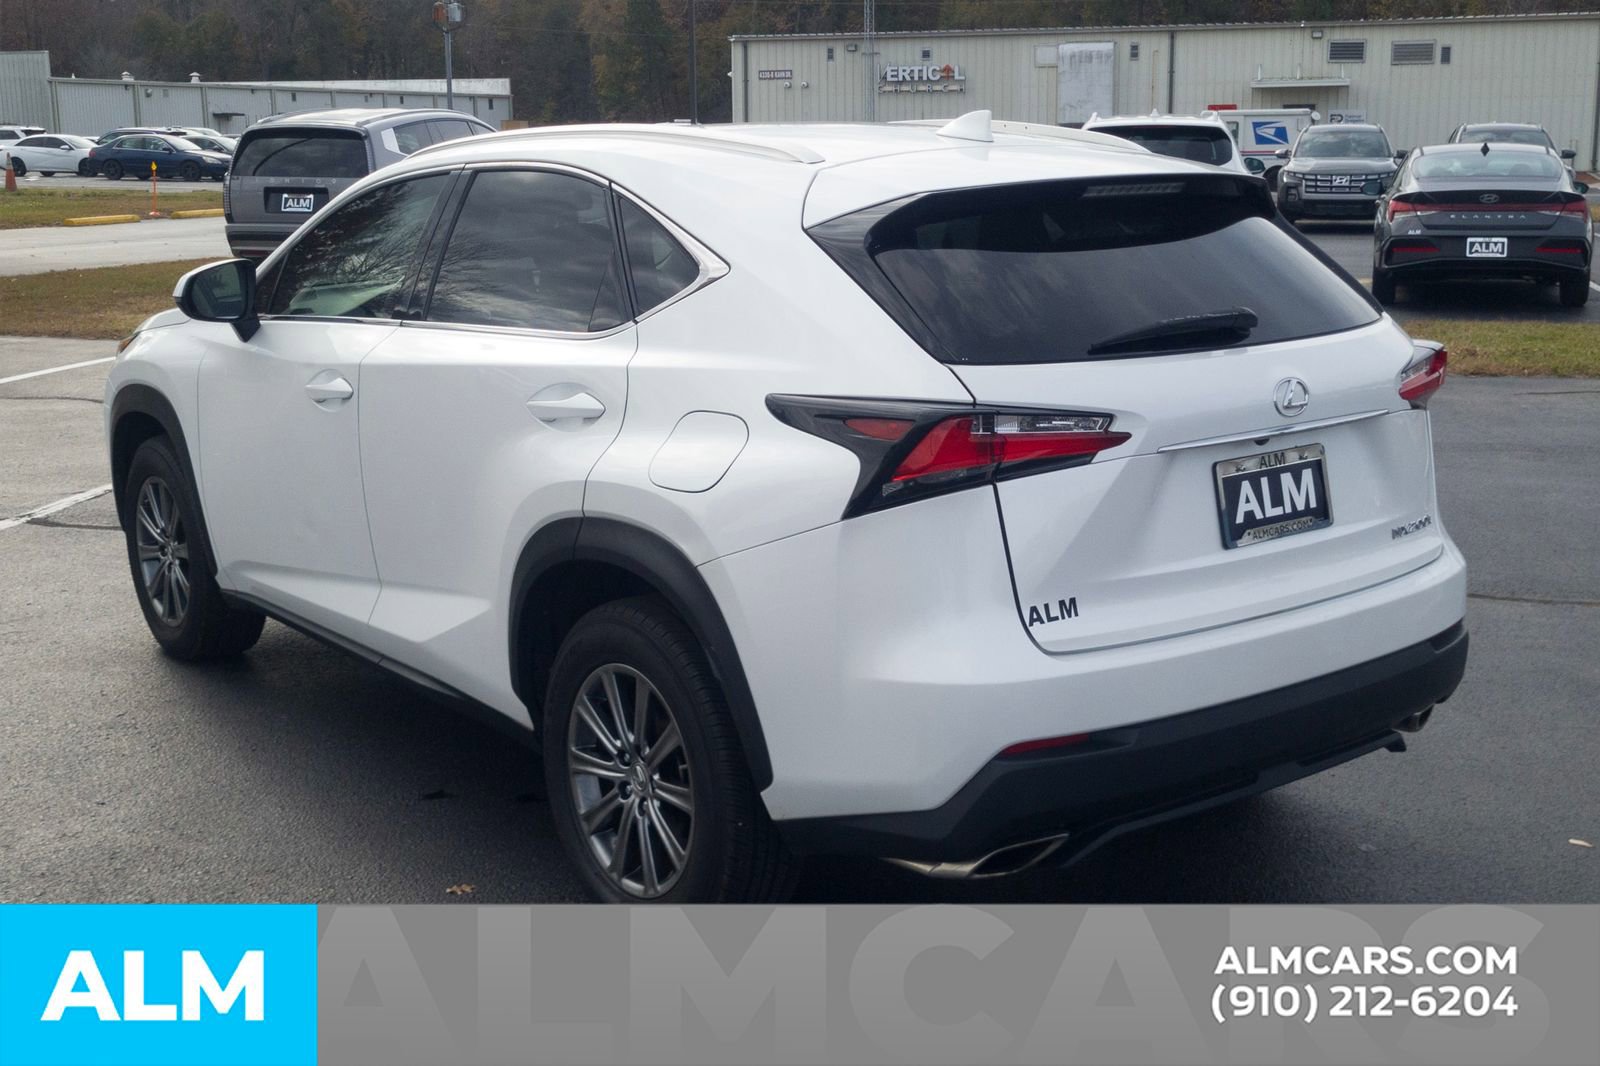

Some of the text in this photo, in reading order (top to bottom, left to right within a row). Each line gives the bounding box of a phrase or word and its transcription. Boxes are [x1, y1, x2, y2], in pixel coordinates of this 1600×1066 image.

[879, 83, 965, 94] CHURCH
[286, 198, 310, 208] ALM
[1471, 242, 1503, 253] ALM
[1259, 452, 1286, 469] ALM
[1235, 468, 1318, 524] ALM
[1028, 597, 1079, 627] ALM
